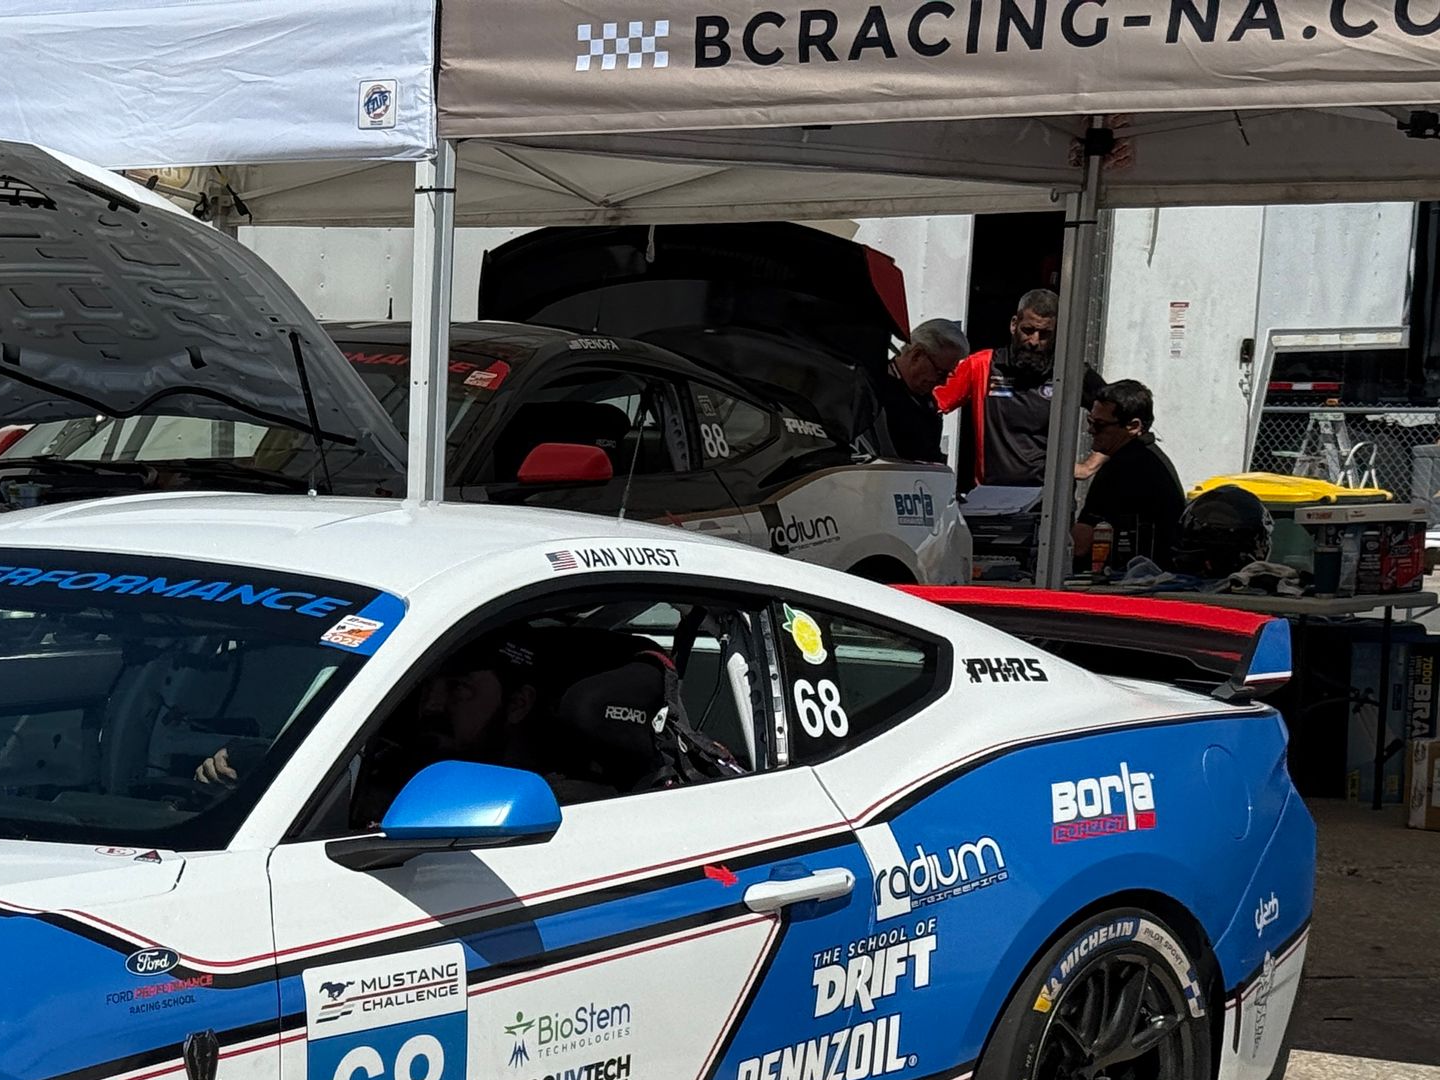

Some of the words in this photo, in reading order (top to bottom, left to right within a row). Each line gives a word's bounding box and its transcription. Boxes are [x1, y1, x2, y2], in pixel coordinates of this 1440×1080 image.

[700, 423, 729, 458] 88
[576, 550, 617, 568] VAN
[616, 548, 680, 567] VURST
[605, 706, 647, 724] RECARO
[793, 679, 849, 738] 68
[813, 947, 840, 968] THE
[848, 928, 907, 957] SCHOOL
[915, 918, 936, 936] OF
[1060, 921, 1134, 979] MICHELIN
[136, 952, 170, 973] Ford
[361, 962, 458, 993] MUSTANG
[812, 935, 937, 1019] DRIFT
[129, 1000, 161, 1015] RACING
[162, 995, 197, 1010] SCHOOL
[362, 983, 459, 1012] CHALLENGE
[538, 1002, 631, 1045] BioStem
[538, 1026, 631, 1059] TECHNOLOGIES
